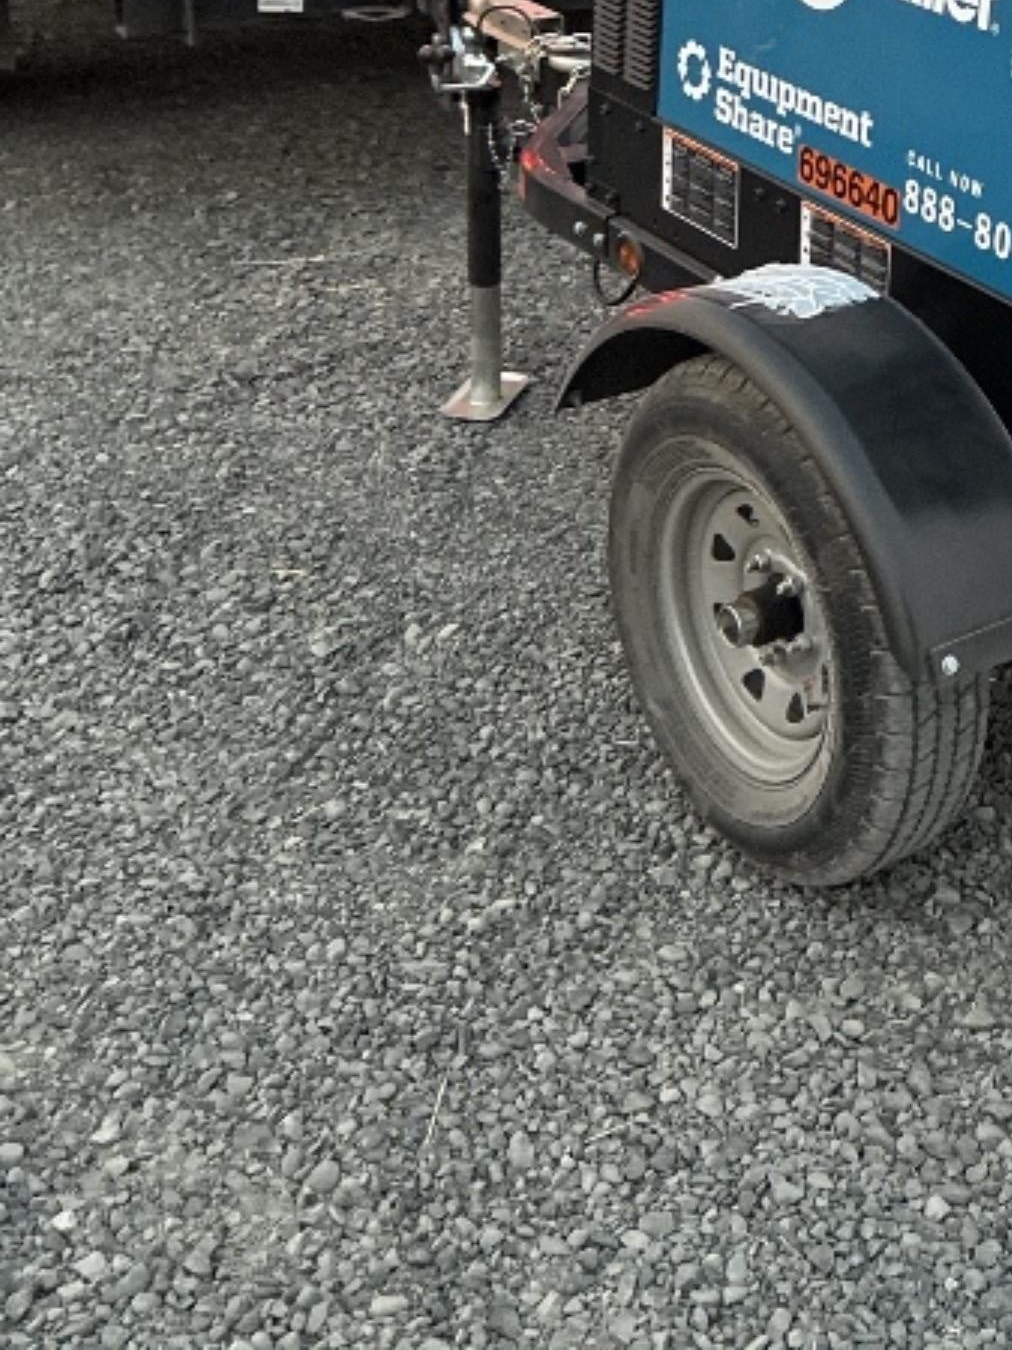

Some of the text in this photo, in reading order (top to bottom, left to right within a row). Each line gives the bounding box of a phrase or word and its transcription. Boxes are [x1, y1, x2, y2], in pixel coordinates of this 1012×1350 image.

[713, 86, 794, 155] Share
[716, 45, 874, 148] Equipment
[799, 145, 898, 226] 696640
[907, 148, 985, 199] CALL NOW
